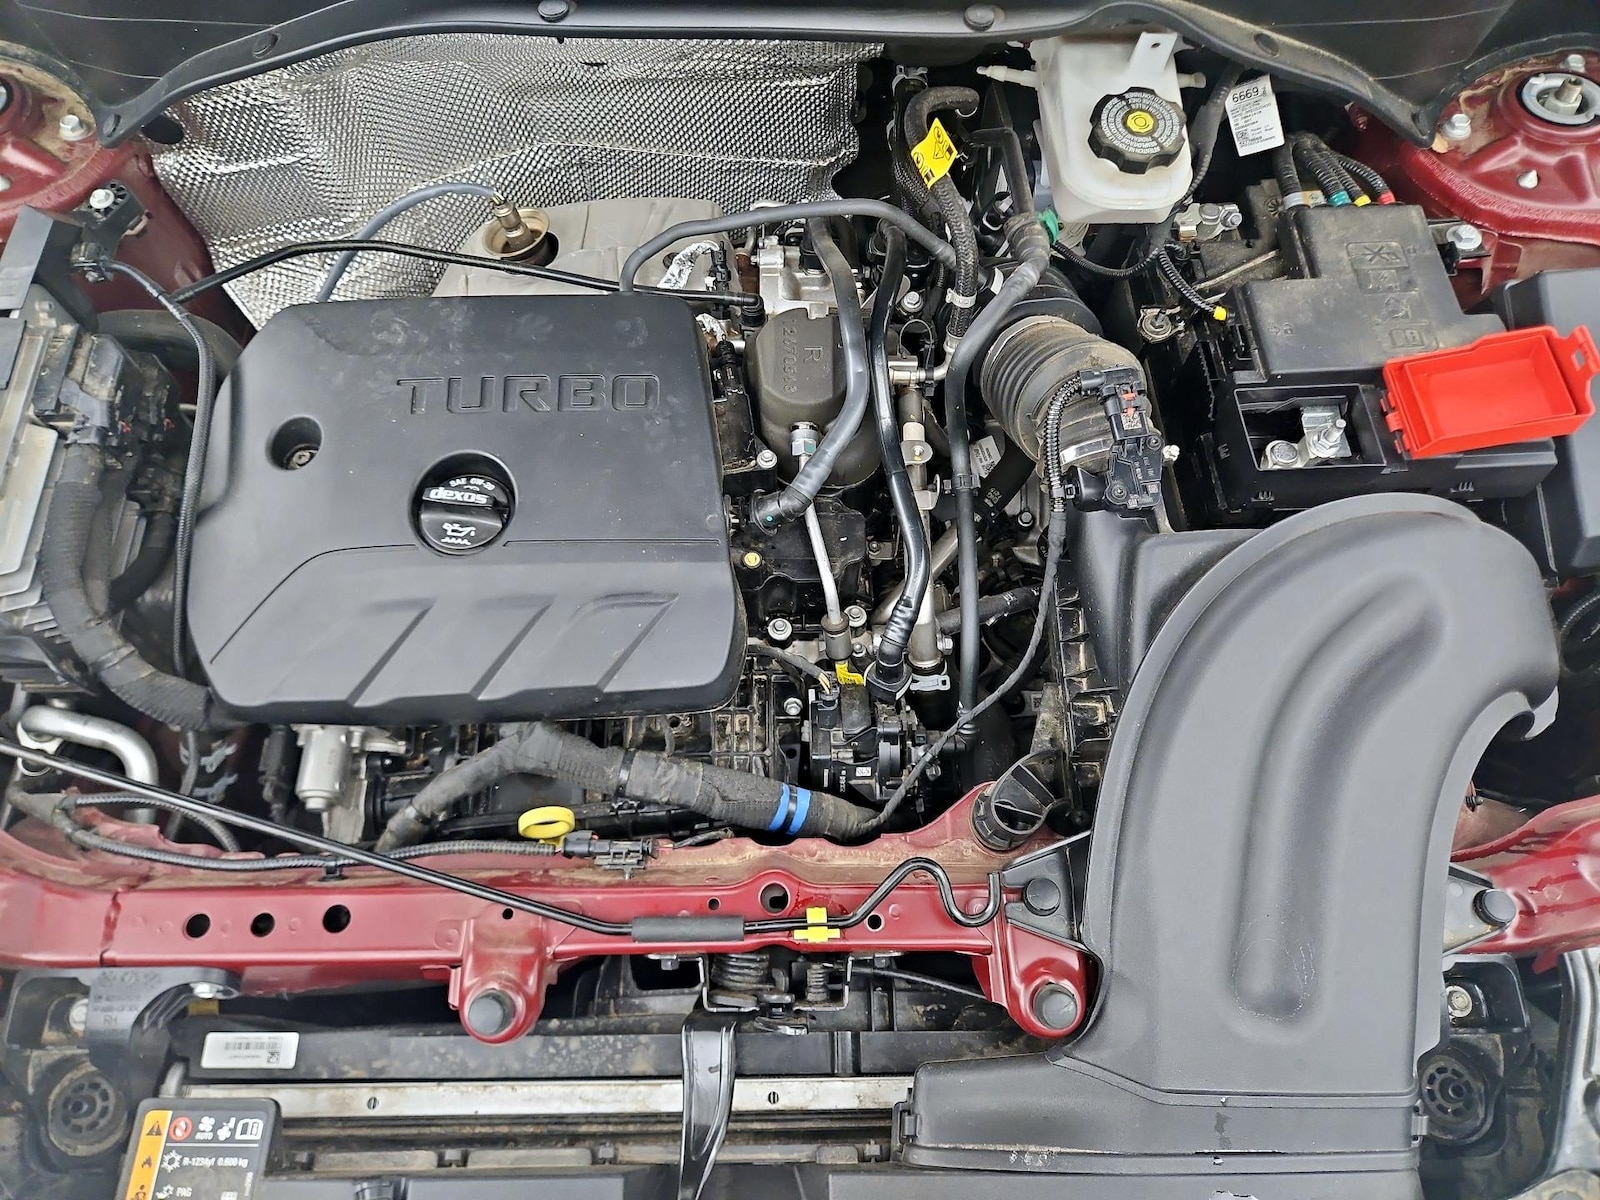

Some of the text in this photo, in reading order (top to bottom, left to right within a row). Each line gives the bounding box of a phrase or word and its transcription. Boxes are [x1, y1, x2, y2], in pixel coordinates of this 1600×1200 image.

[1232, 86, 1259, 103] 6669
[397, 374, 660, 414] TURBO
[449, 478, 496, 491] SAE 0W-20
[429, 487, 490, 504] dexos
[195, 1132, 213, 1141] AUTO
[176, 1187, 193, 1198] PAG
